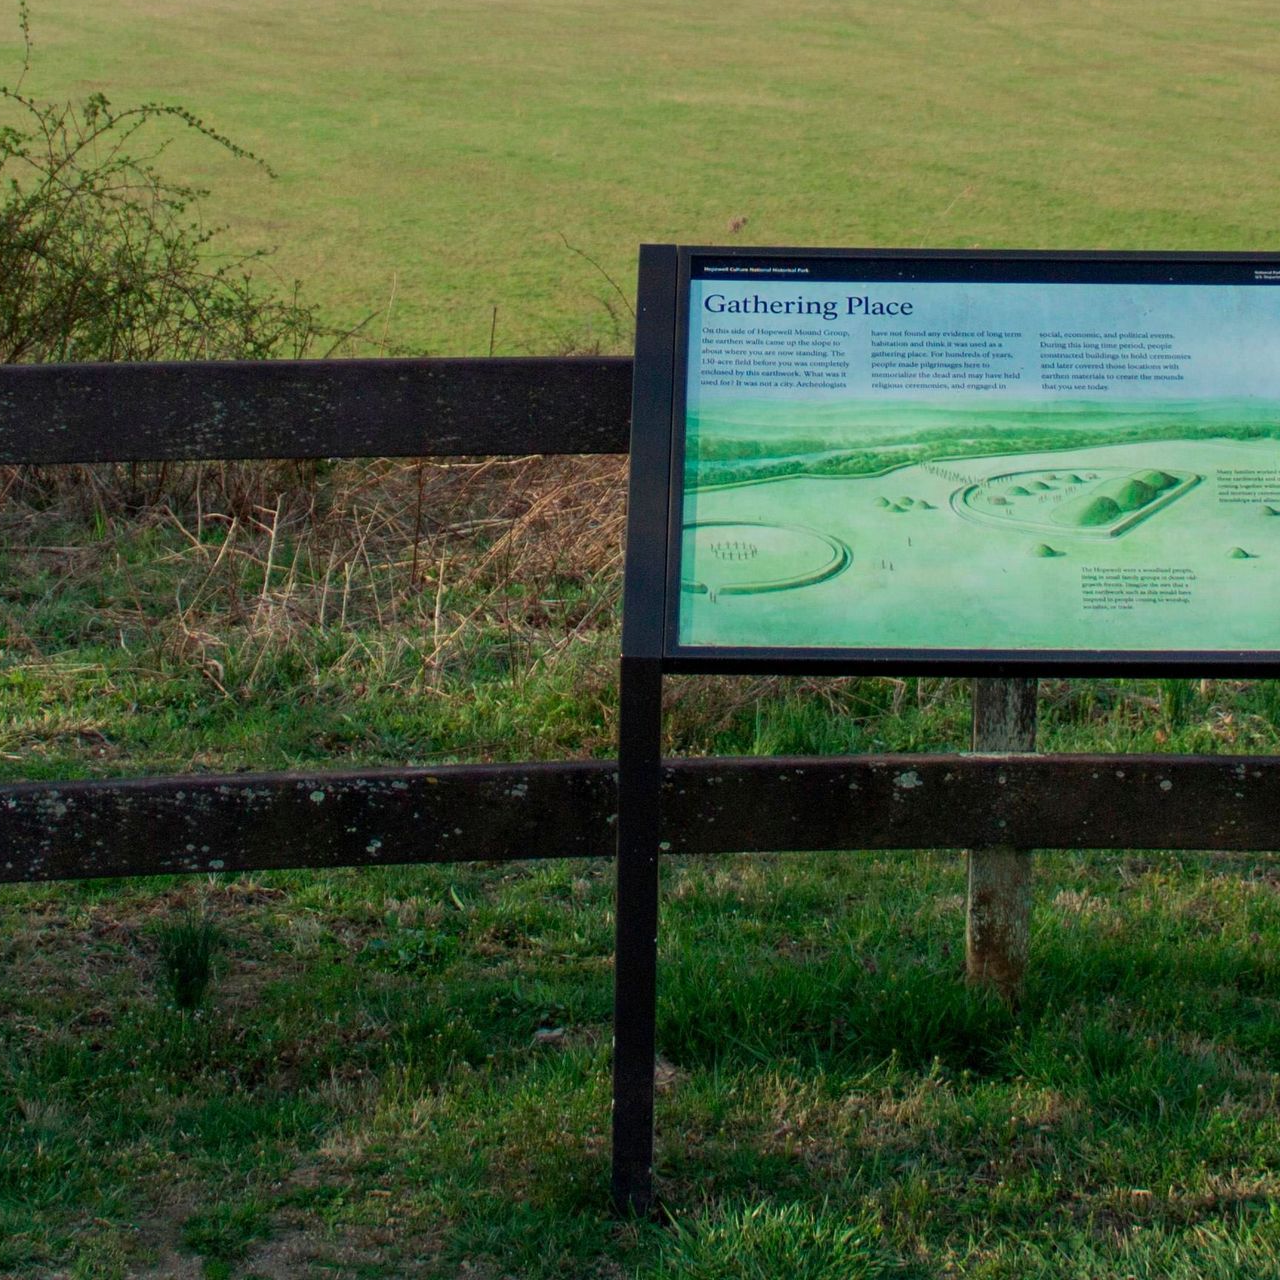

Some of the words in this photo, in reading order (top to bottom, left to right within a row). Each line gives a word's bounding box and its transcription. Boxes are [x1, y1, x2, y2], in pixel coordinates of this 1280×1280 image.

[704, 294, 838, 320] Gathering
[846, 296, 913, 316] Place
[702, 326, 714, 334] On
[716, 326, 729, 334] this
[730, 327, 745, 335] side
[747, 327, 756, 335] of
[757, 327, 792, 337] Hopewell
[794, 328, 821, 336] Mound
[871, 329, 888, 337] have
[904, 329, 926, 337] found
[928, 331, 940, 339] any
[942, 330, 975, 338] evidence
[977, 330, 985, 338] of
[986, 330, 1003, 340] long
[1039, 330, 1062, 339] social,
[1064, 331, 1102, 340] economic,
[1104, 331, 1117, 339] and
[1119, 331, 1148, 341] political
[702, 336, 713, 344] the
[715, 337, 744, 345] earthen
[745, 337, 764, 345] walls
[786, 340, 796, 348] up
[798, 338, 810, 346] the
[812, 339, 831, 348] slope
[871, 339, 908, 347] habitation
[910, 339, 924, 347] and
[926, 340, 946, 348] think
[947, 340, 952, 348] it
[970, 340, 987, 348] used
[1040, 341, 1066, 350] During
[1068, 341, 1082, 349] this
[1083, 341, 1100, 351] long
[1119, 341, 1146, 351] period,
[1147, 342, 1172, 352] people
[702, 347, 723, 355] about
[725, 347, 747, 355] where
[831, 349, 845, 357] The
[871, 350, 906, 359] gathering
[931, 350, 943, 358] For
[945, 350, 980, 358] hundreds
[982, 350, 990, 358] of
[992, 352, 1014, 360] years,
[1040, 351, 1084, 359] constructed
[1086, 351, 1119, 361] buildings
[1131, 352, 1148, 360] hold
[1149, 352, 1191, 360] ceremonies
[735, 358, 751, 366] field
[753, 358, 776, 366] before
[809, 360, 850, 369] completely
[871, 360, 896, 370] people
[898, 360, 919, 368] made
[920, 361, 962, 370] pilgrimages
[964, 361, 980, 369] here
[1041, 361, 1055, 369] and
[1057, 361, 1073, 369] later
[1075, 362, 1104, 370] covered
[1106, 362, 1126, 370] those
[1128, 362, 1161, 370] locations
[1163, 362, 1179, 370] with
[701, 368, 733, 376] enclosed
[735, 368, 744, 378] by
[746, 368, 760, 376] this
[761, 369, 801, 377] earthwork.
[804, 370, 823, 378] What
[871, 370, 917, 378] memorialize
[918, 371, 930, 379] the
[932, 371, 950, 379] dead
[952, 371, 966, 379] and
[968, 373, 983, 381] may
[985, 371, 1002, 379] have
[1004, 371, 1021, 379] held
[1041, 372, 1070, 380] earthen
[1072, 372, 1105, 380] materials
[1140, 373, 1152, 381] the
[1153, 373, 1184, 381] mounds
[701, 378, 718, 386] used
[720, 378, 734, 386] for?
[736, 378, 742, 386] It
[796, 380, 847, 390] Archeologists
[871, 381, 903, 391] religious
[905, 382, 949, 391] ceremonies,
[951, 382, 965, 390] and
[967, 382, 997, 391] engaged
[999, 382, 1006, 390] in
[1042, 382, 1057, 390] that
[1059, 384, 1073, 392] you
